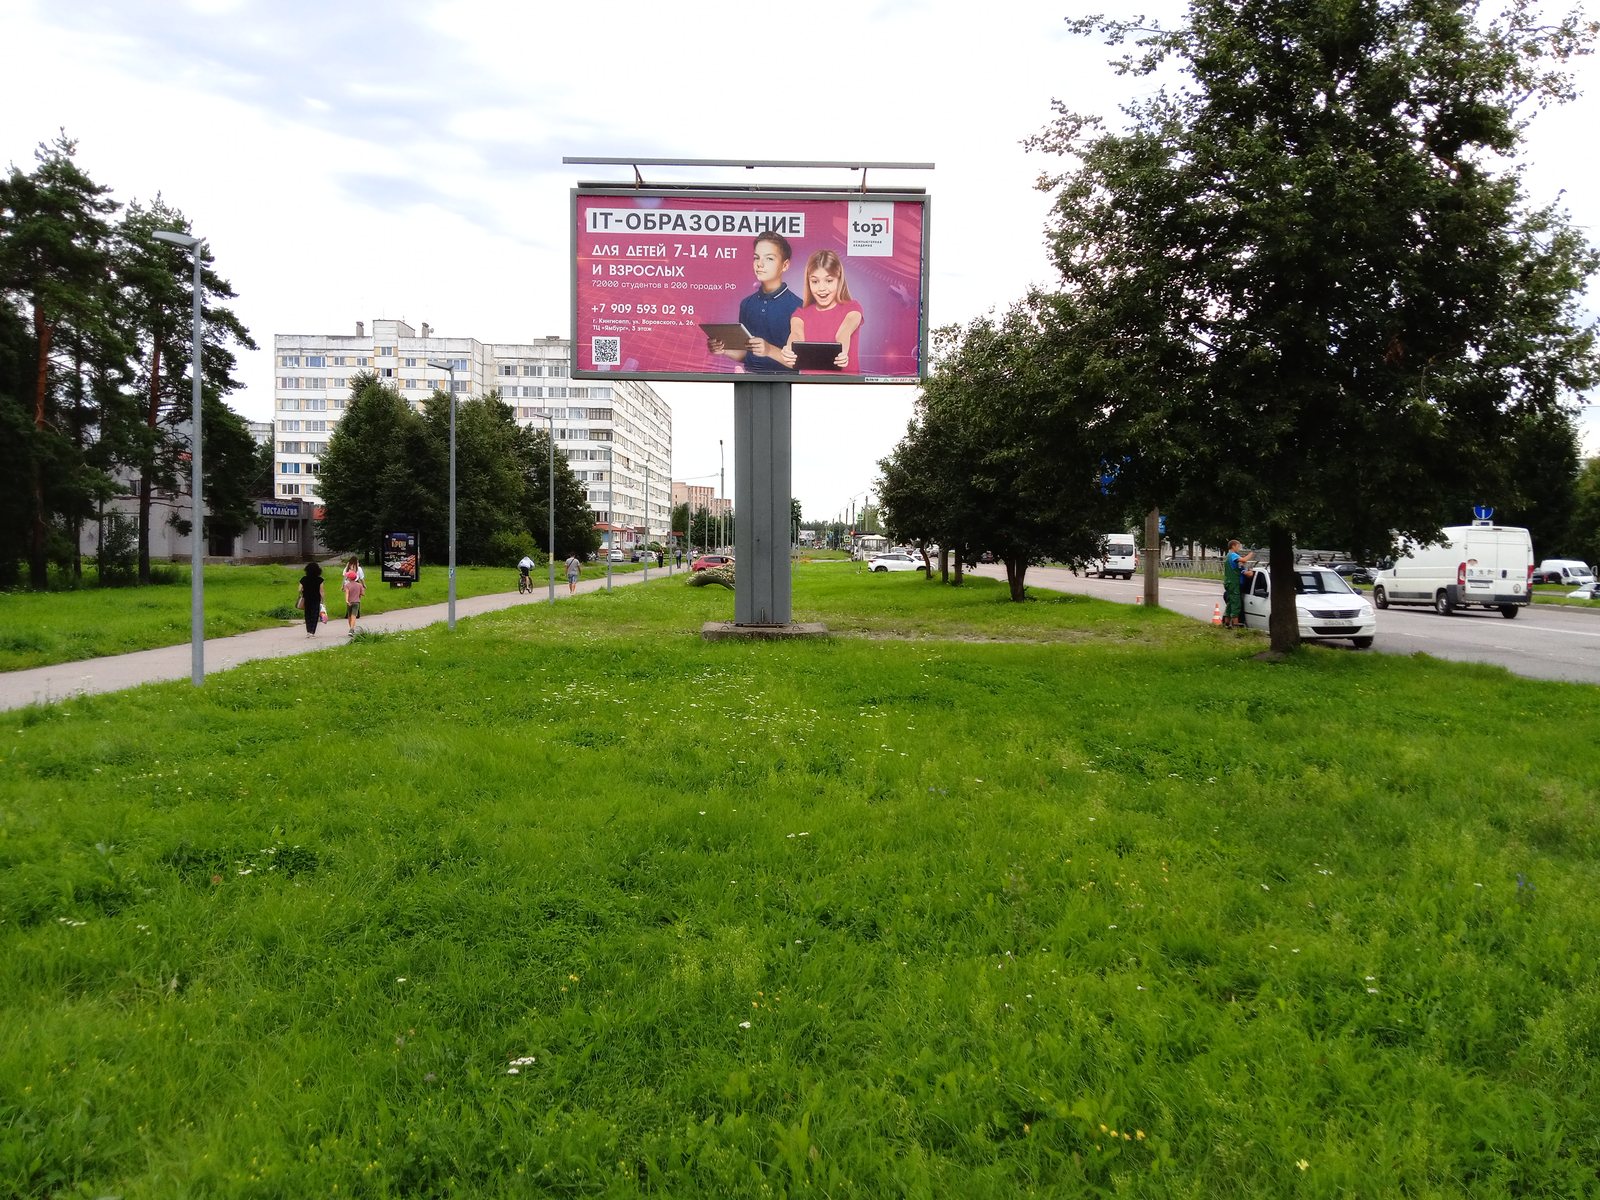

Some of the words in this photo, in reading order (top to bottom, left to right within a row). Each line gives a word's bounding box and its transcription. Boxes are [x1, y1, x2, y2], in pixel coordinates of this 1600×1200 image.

[592, 212, 801, 233] IT-ОБРАЗОВАНИЕ
[852, 220, 883, 236] top
[592, 244, 619, 256] ДЛЯ
[626, 243, 666, 257] ДЕТЕЙ
[674, 244, 708, 258] 7-14
[715, 247, 738, 259] ЛЕТ
[592, 264, 602, 275] И
[609, 264, 685, 277] ВЗРОСЛЫХ
[592, 279, 619, 288] 72000
[621, 282, 662, 290] студентов
[671, 281, 688, 290] 200
[690, 283, 723, 291] городах
[725, 282, 737, 290] РФ
[591, 303, 606, 313] +7
[610, 303, 632, 314] 909
[636, 304, 658, 315] 593
[661, 304, 676, 315] 02
[680, 304, 695, 315] 98
